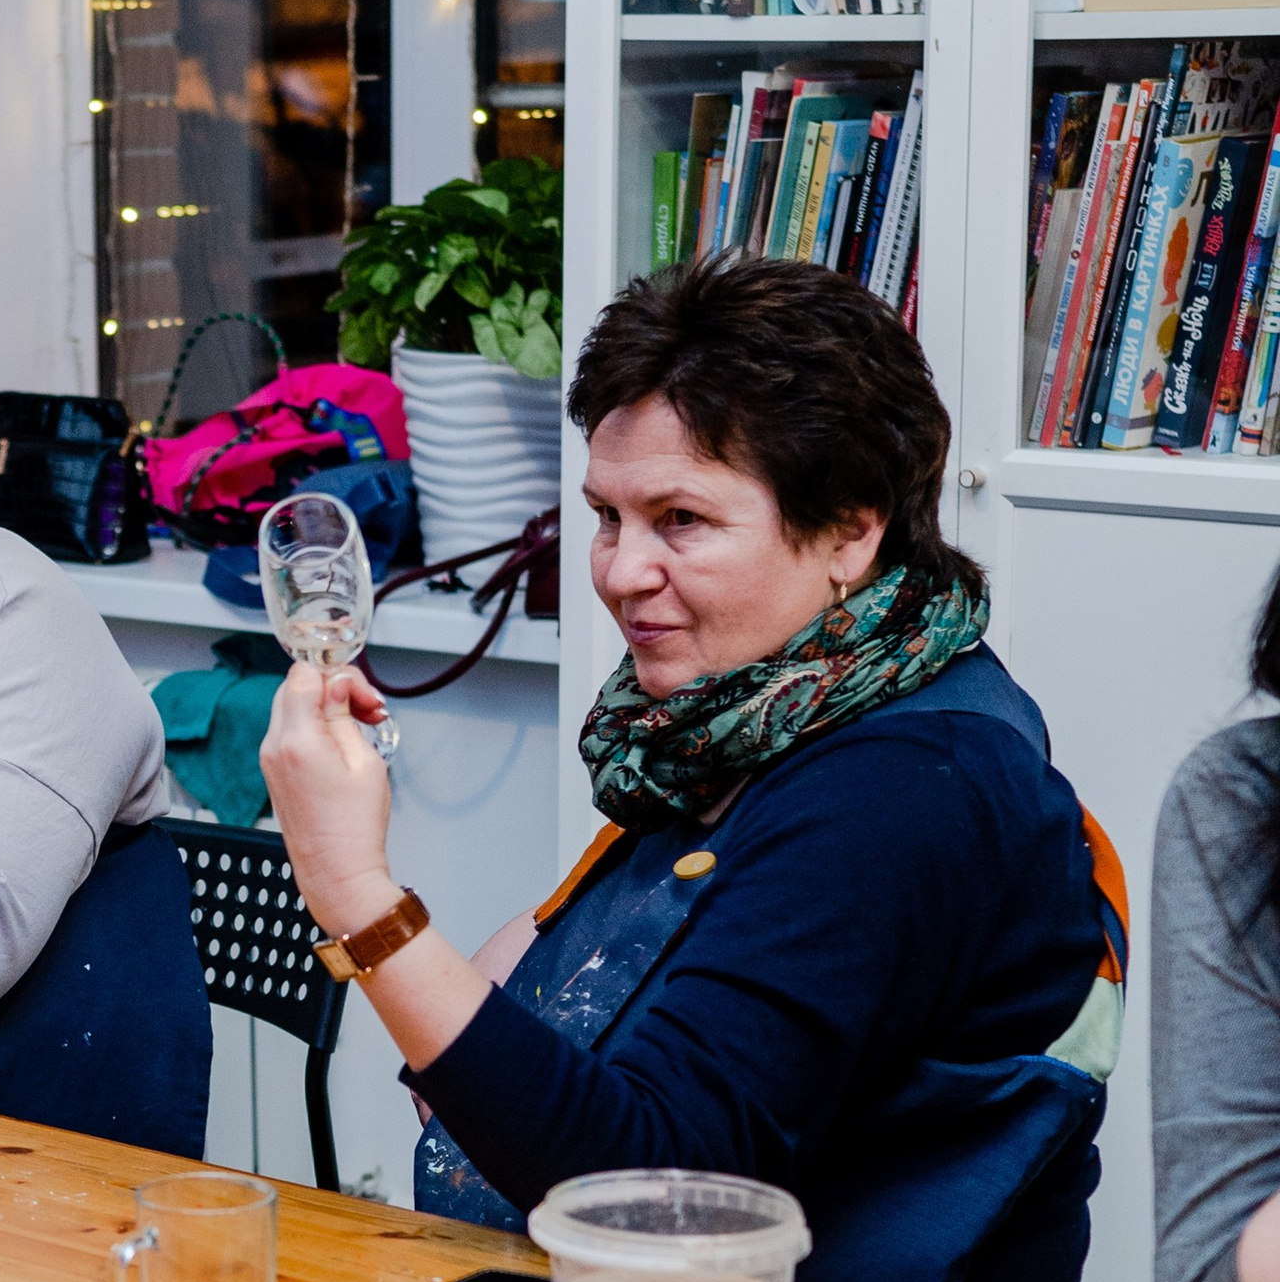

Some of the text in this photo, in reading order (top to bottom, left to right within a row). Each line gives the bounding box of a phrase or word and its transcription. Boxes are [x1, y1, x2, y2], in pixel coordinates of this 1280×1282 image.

[1086, 122, 1108, 189] РАСКРАШИВАЕМ
[1156, 110, 1169, 134] Марк
[657, 203, 669, 260] СТУДИЯ
[853, 141, 879, 234] ЧУДО-ЖЕНЩИНА
[1075, 199, 1091, 244] ОТДЫХАЕМ
[1087, 140, 1139, 341] Творческая мастерская юного художника
[1231, 301, 1251, 353] БОЛЬШАЯ
[1243, 265, 1257, 303] КНИГА
[1262, 170, 1278, 227] ДРАКОНАХ
[1114, 184, 1171, 405] ЛЮДИ В КАРТИНКАХ
[1164, 362, 1194, 415] Сказки
[1181, 294, 1210, 342] Ночь
[1203, 214, 1224, 256] ЮНЫХ
